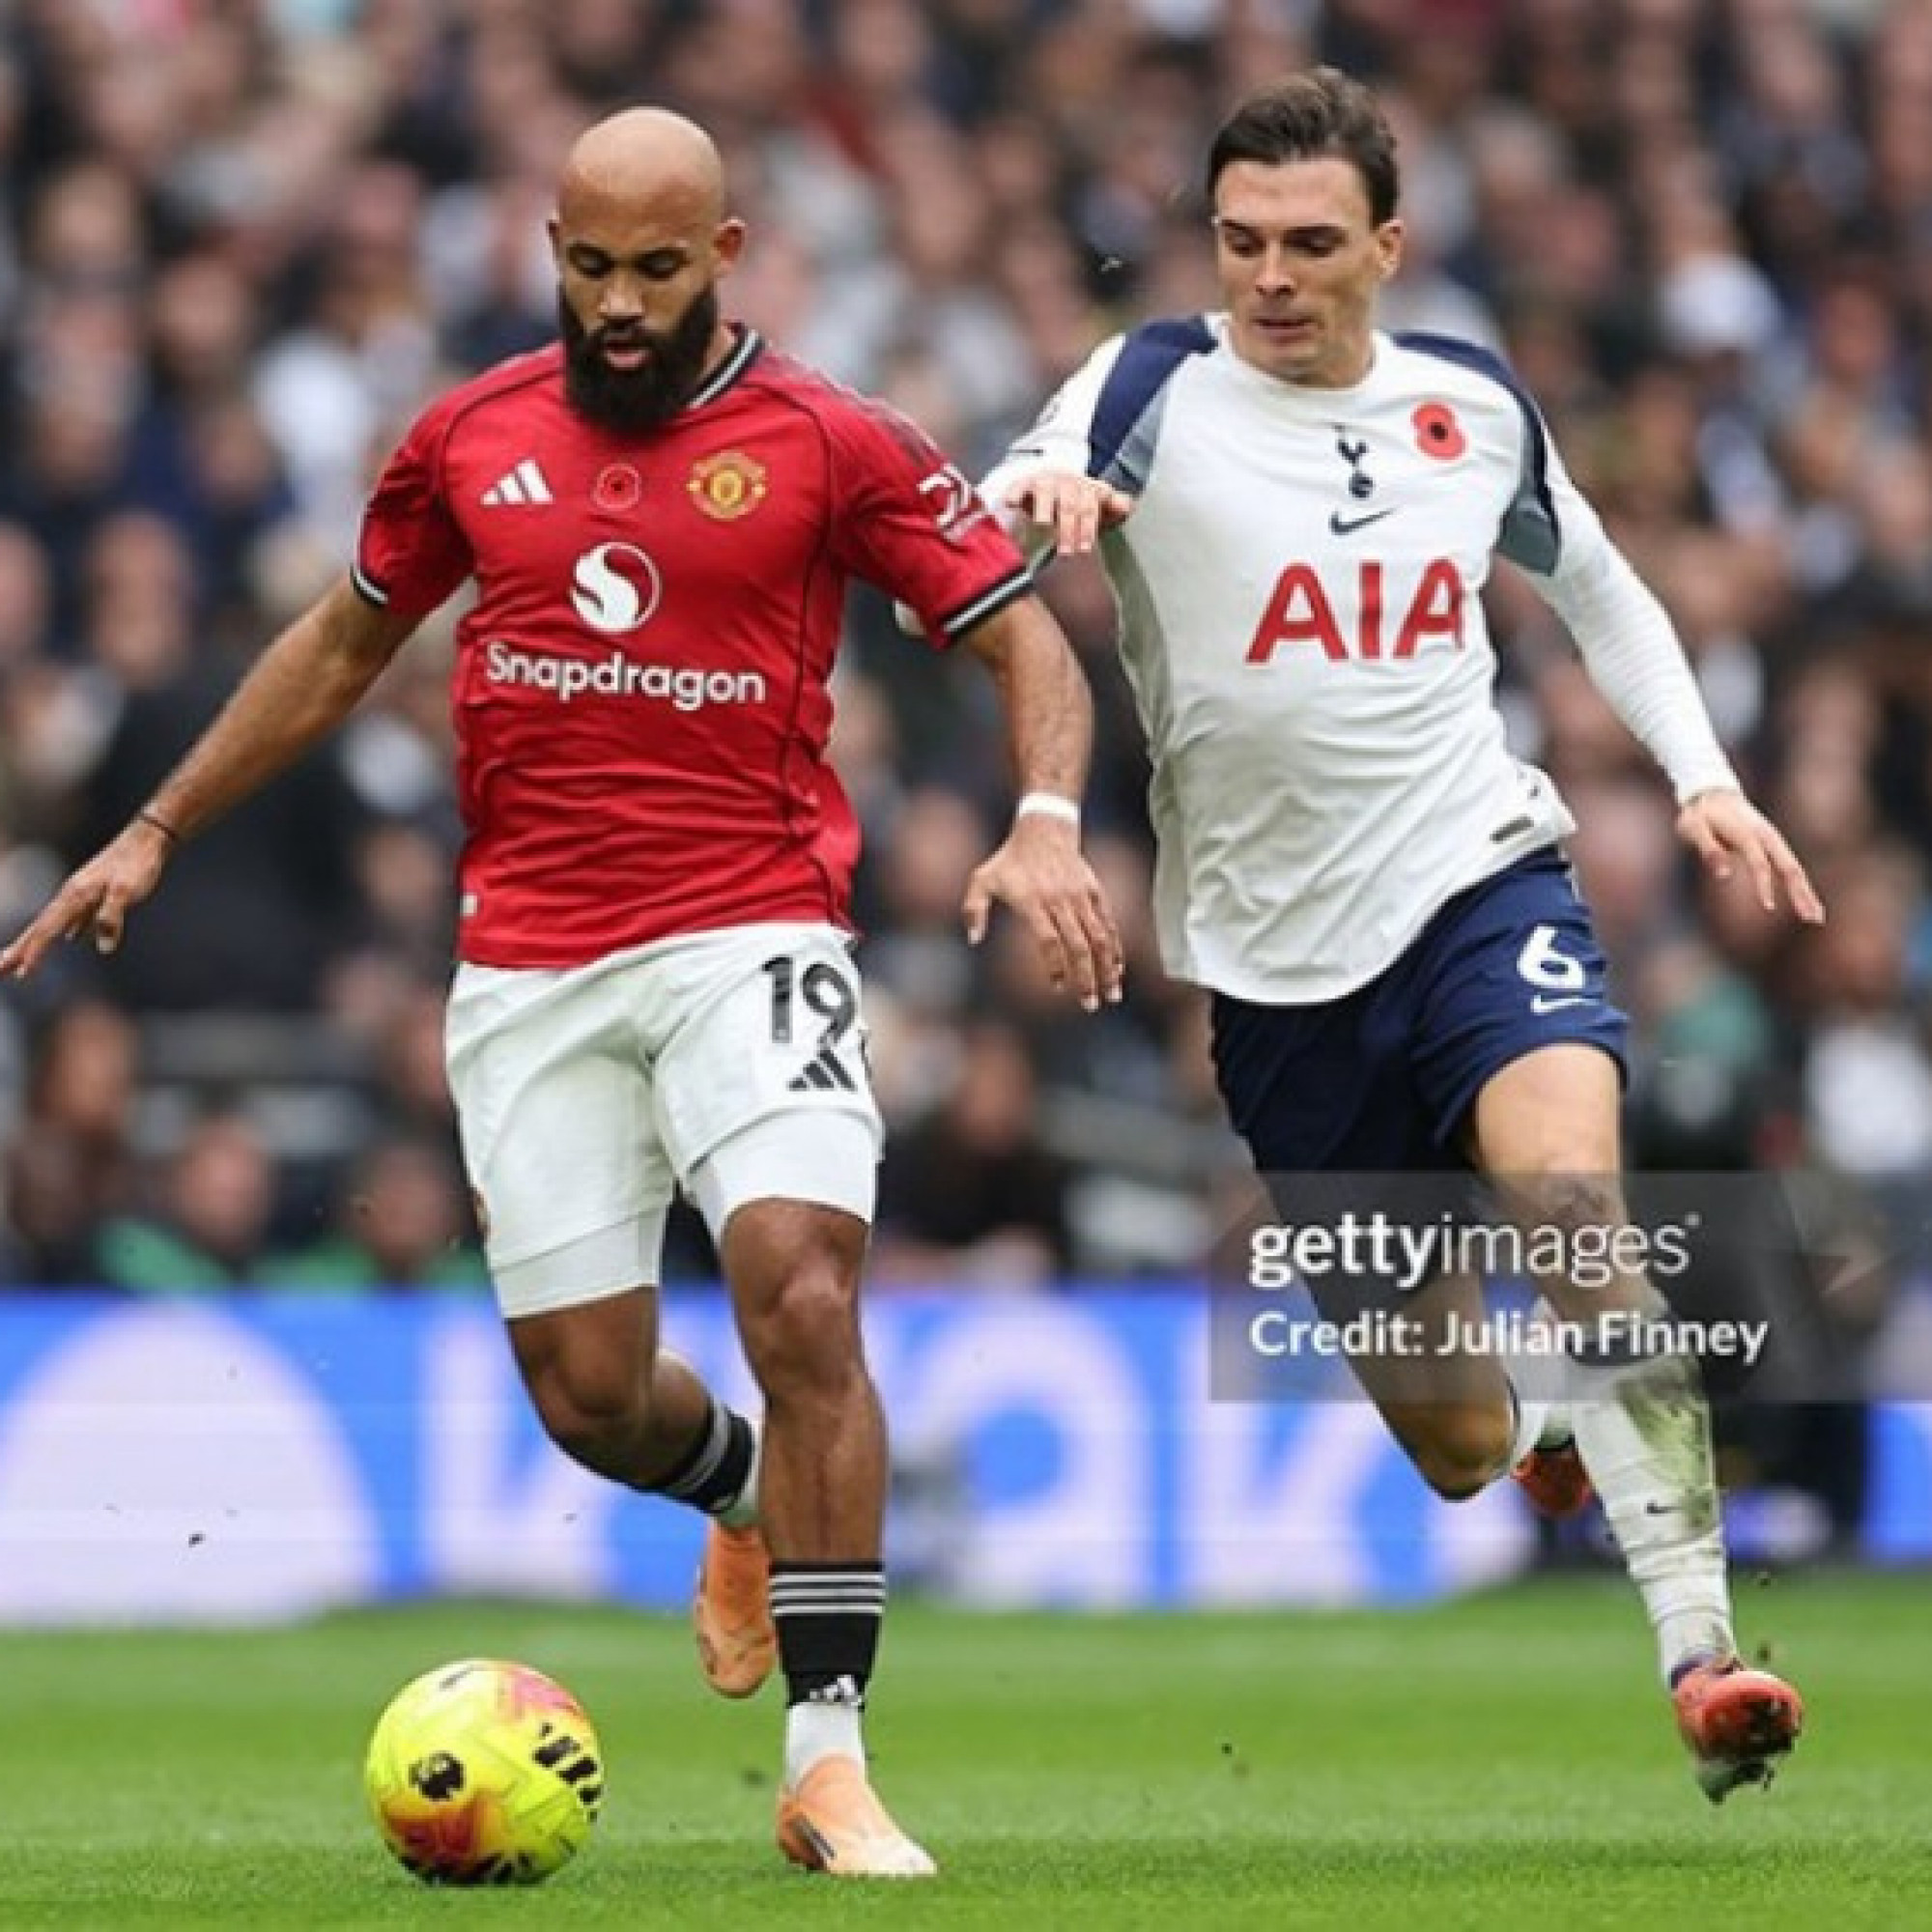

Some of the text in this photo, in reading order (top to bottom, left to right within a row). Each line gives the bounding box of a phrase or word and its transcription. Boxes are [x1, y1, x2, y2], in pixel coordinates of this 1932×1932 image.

[1245, 557, 1465, 664] AIA
[485, 641, 766, 710] Snapdragon
[1517, 923, 1585, 989] 6
[760, 954, 855, 1048] 19
